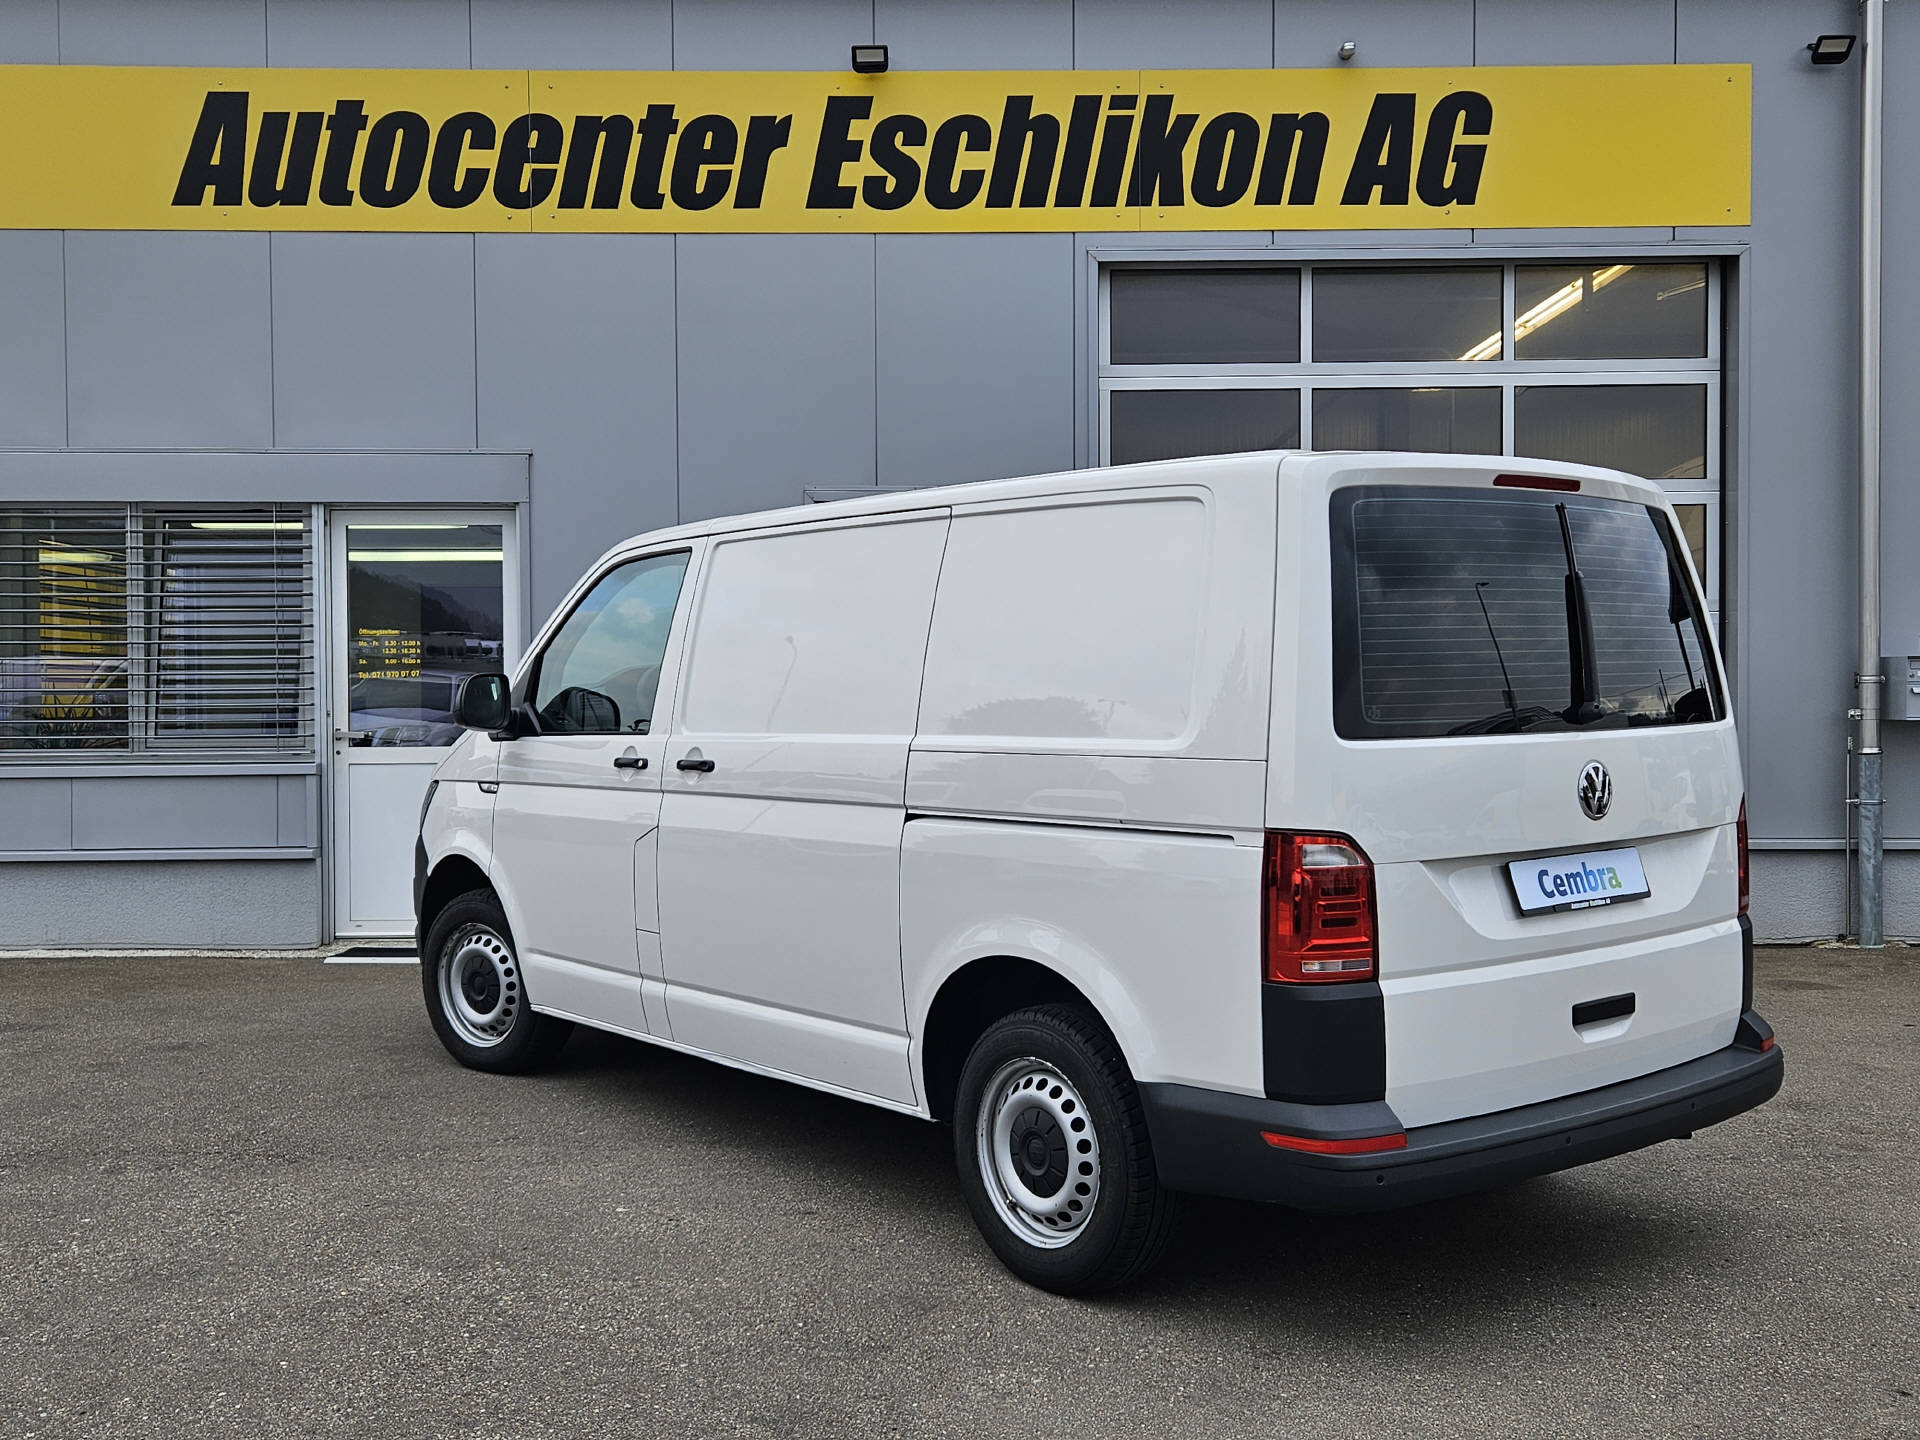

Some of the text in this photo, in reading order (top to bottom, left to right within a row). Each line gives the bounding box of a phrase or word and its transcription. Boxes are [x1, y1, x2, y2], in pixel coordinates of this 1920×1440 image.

[170, 90, 1493, 211] Autocenter Eschlikon AG
[359, 671, 371, 679] Tel.
[400, 670, 409, 678] 07
[1537, 861, 1622, 899] Cembra
